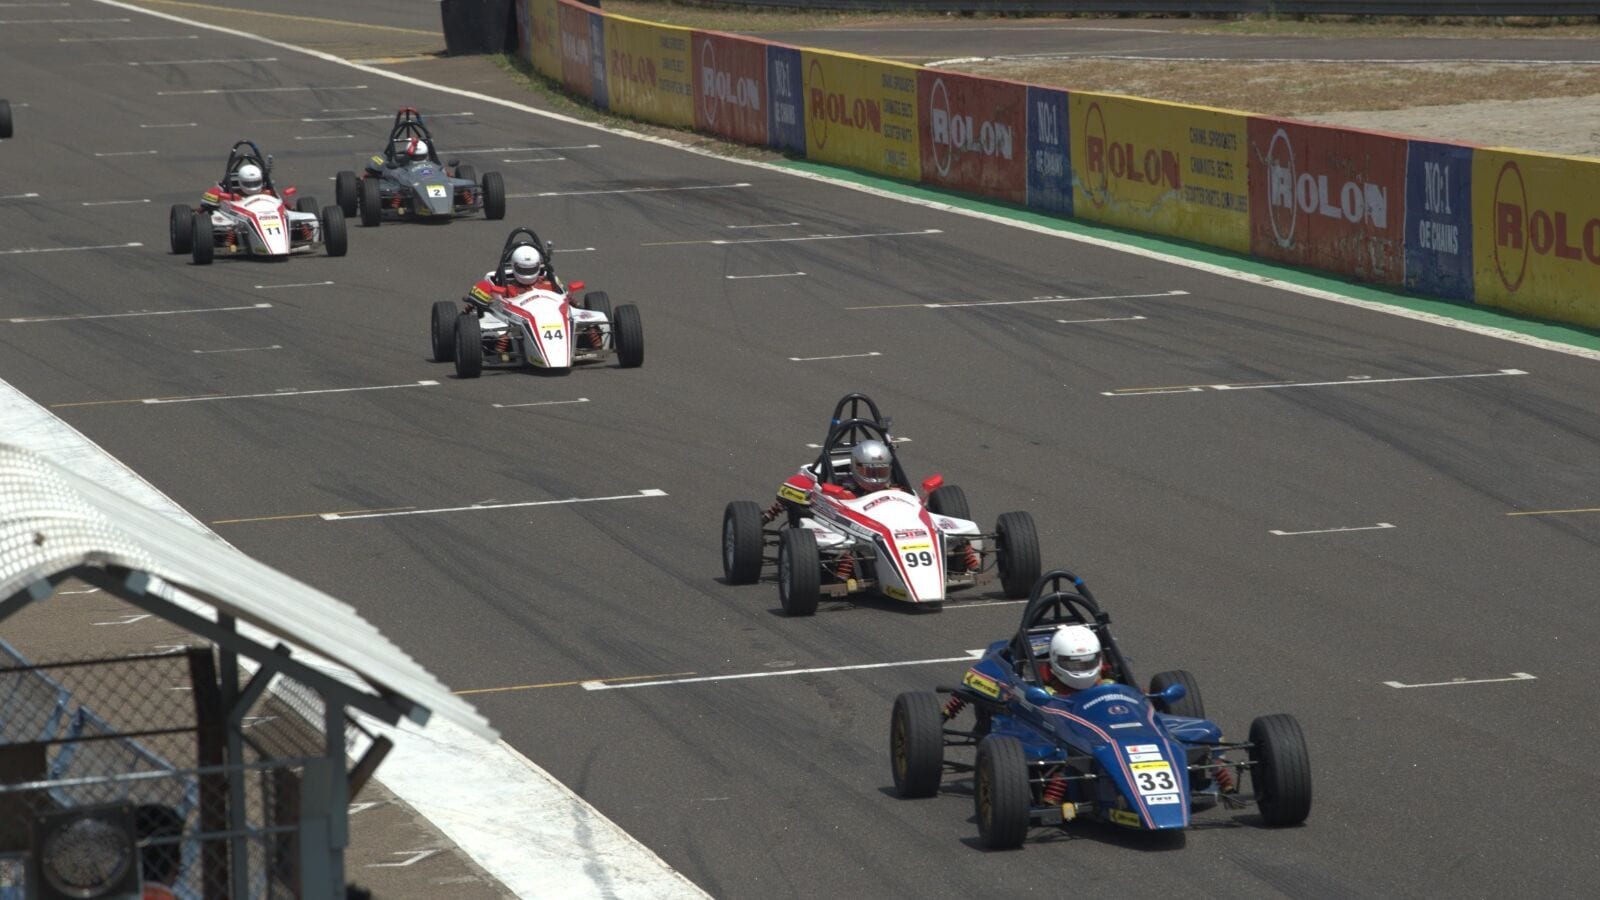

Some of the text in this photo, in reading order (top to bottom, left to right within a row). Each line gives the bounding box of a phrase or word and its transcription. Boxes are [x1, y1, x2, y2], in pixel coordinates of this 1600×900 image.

[704, 67, 760, 111] ROLON
[811, 88, 880, 133] ROLON
[932, 109, 1013, 160] ROLON
[1088, 136, 1181, 190] ROLON
[433, 189, 441, 197] 2
[1271, 166, 1387, 228] ROLON
[266, 227, 281, 235] 11
[1432, 222, 1459, 254] CHAINS
[543, 329, 564, 340] 44
[905, 551, 932, 568] 99
[1138, 771, 1174, 791] 33
